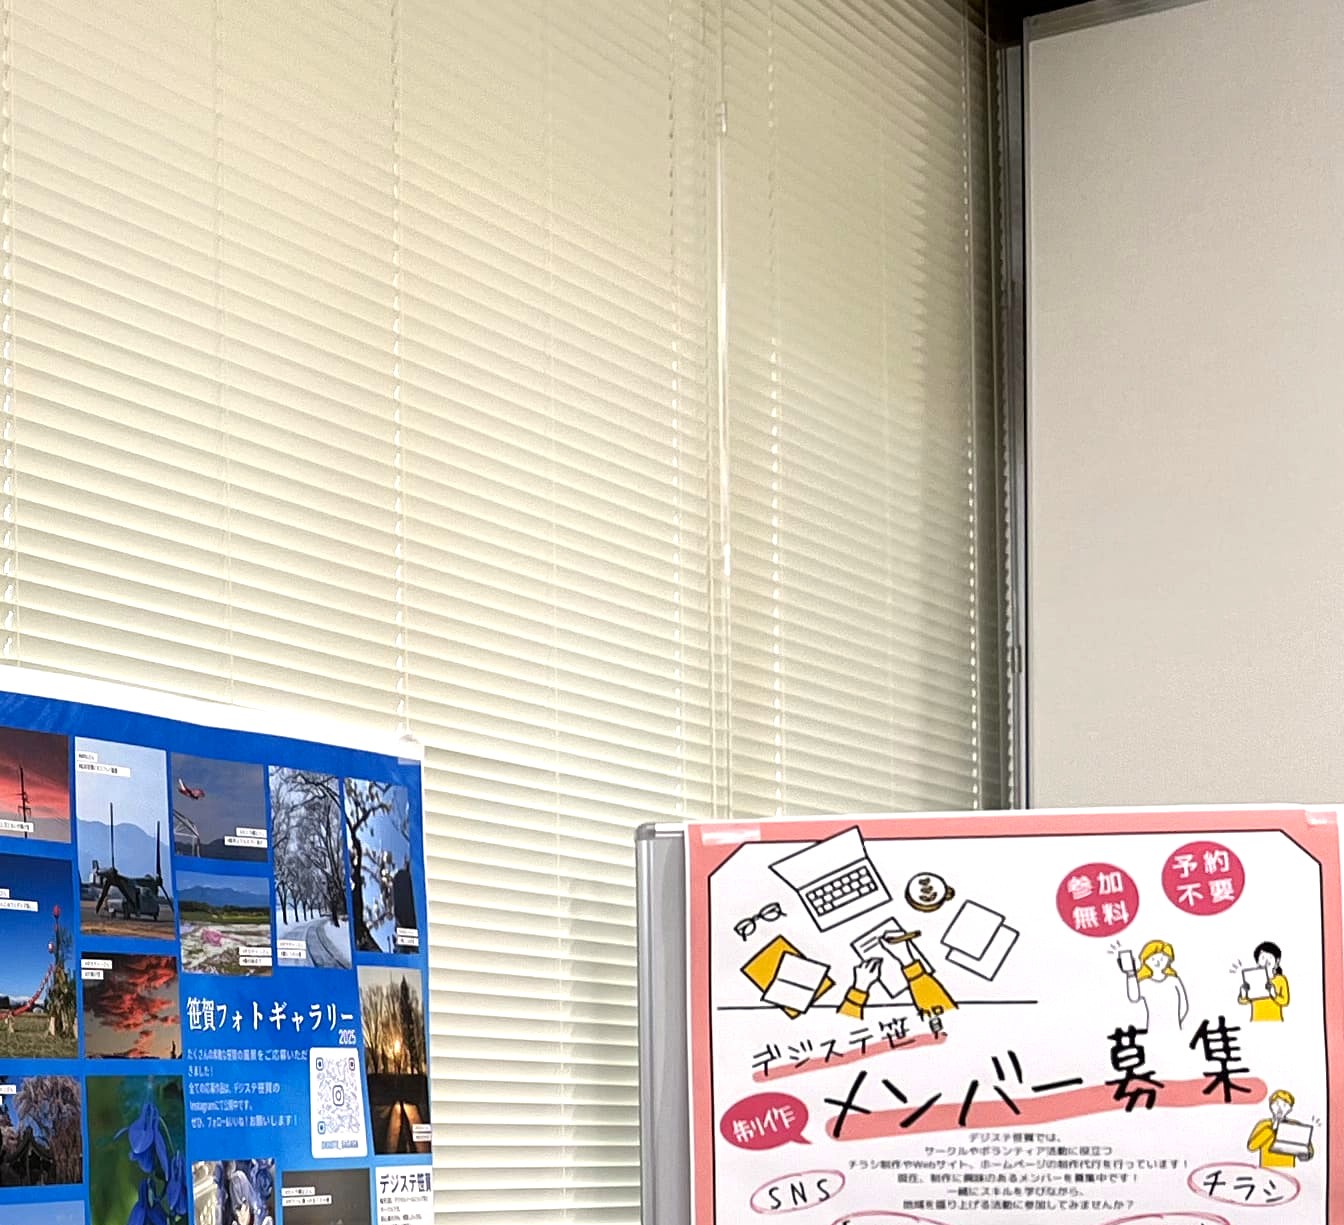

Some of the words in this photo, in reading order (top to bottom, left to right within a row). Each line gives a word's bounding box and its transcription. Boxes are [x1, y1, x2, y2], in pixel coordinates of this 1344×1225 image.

[1170, 848, 1231, 875] 予約
[1066, 871, 1124, 902] 参加
[1175, 878, 1237, 907] 不要
[1071, 902, 1131, 930] 無料
[186, 997, 355, 1033] 笹賀フォトギャラリー
[338, 1029, 357, 1045] 2025
[751, 1005, 948, 1077] デジステ笹賀
[823, 1015, 1252, 1138] メンバー募集
[731, 1104, 797, 1143] 制作
[768, 1179, 831, 1210] SNS
[1203, 1170, 1284, 1204] チラシ
